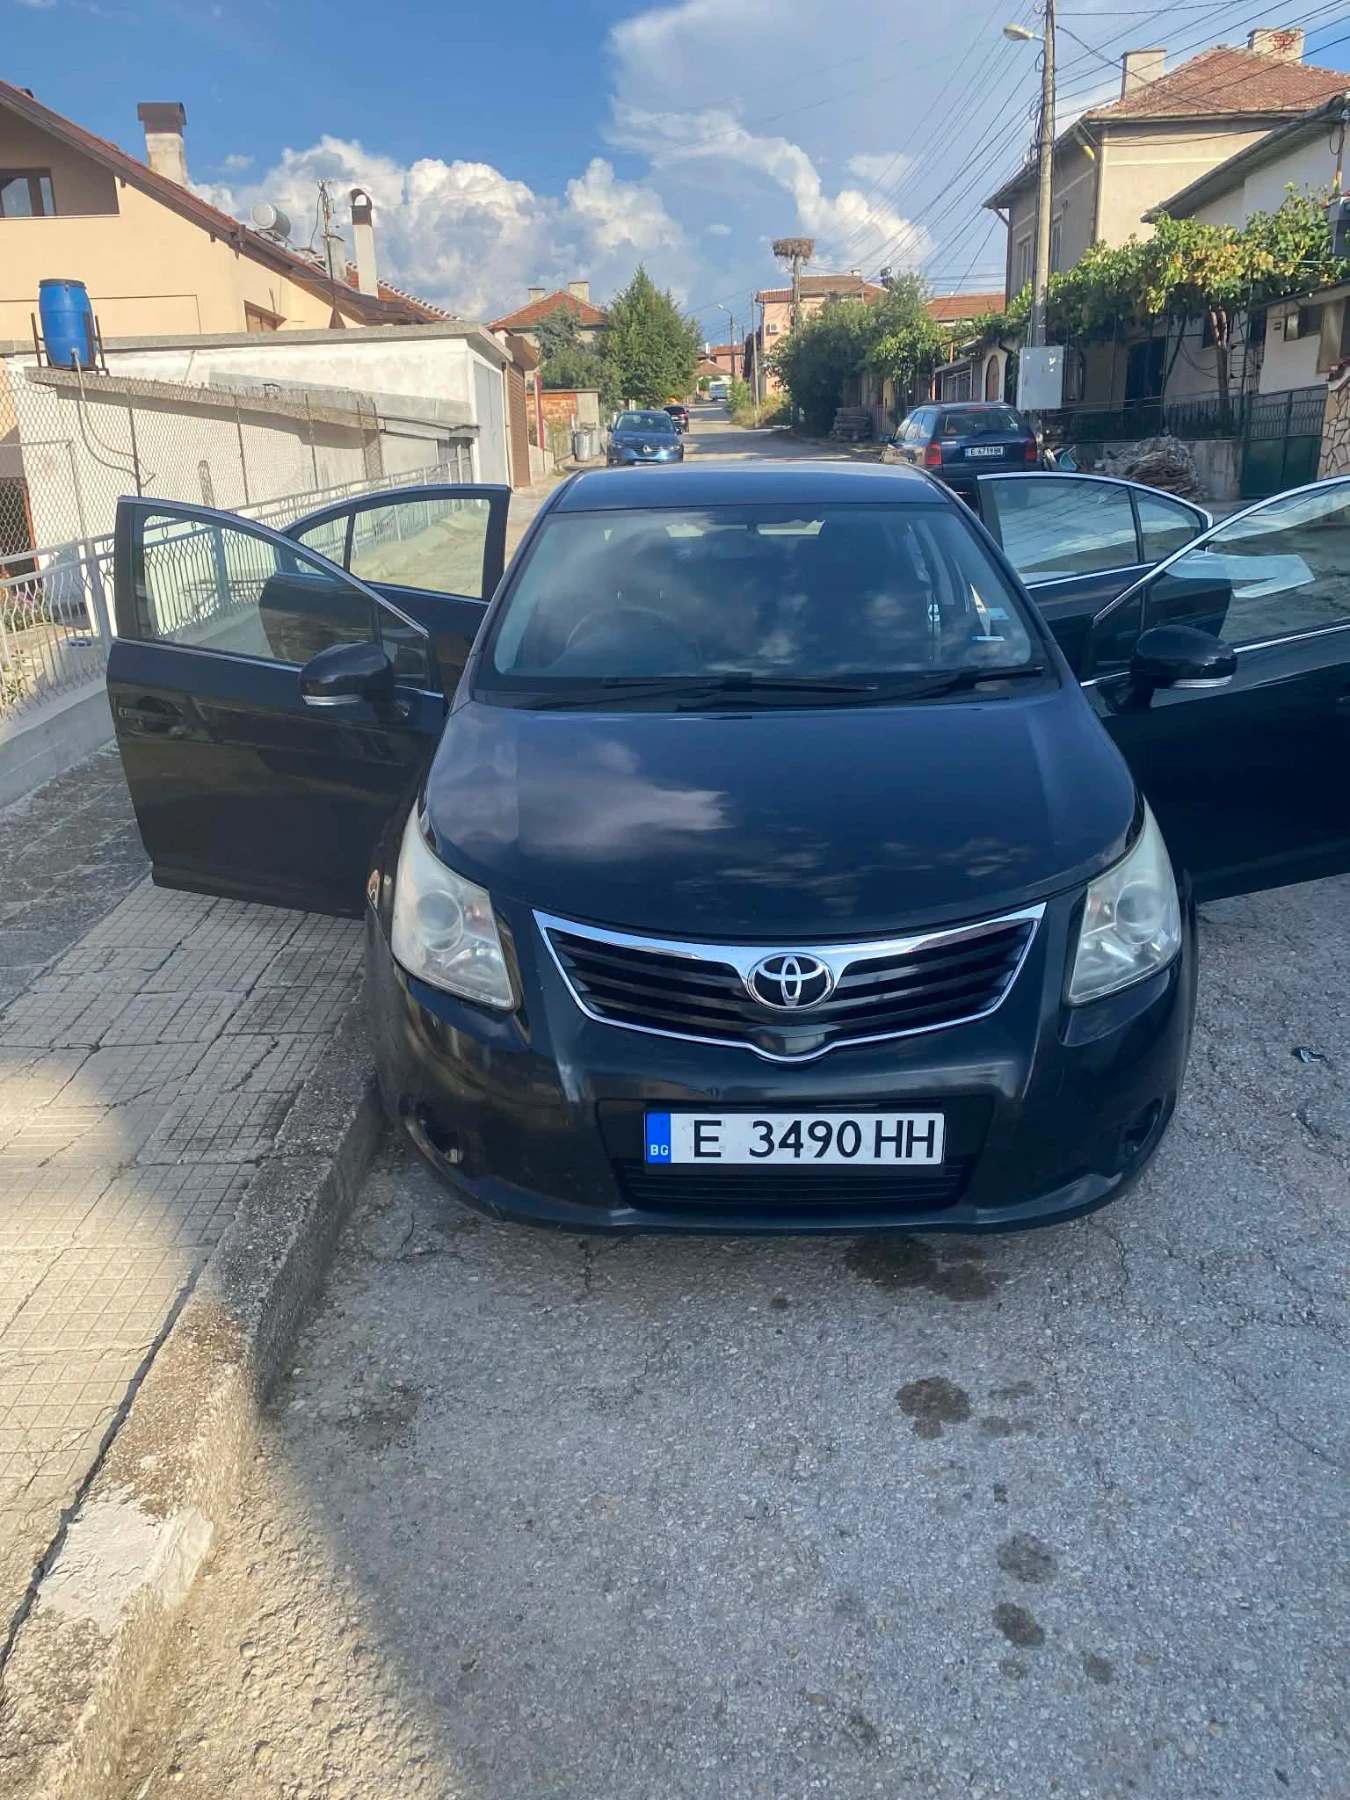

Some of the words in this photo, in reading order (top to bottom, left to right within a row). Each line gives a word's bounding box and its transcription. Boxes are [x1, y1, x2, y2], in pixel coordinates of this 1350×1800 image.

[650, 1145, 669, 1155] BG
[694, 1120, 722, 1157] E
[749, 1120, 861, 1158] 3490
[874, 1120, 935, 1158] HH
